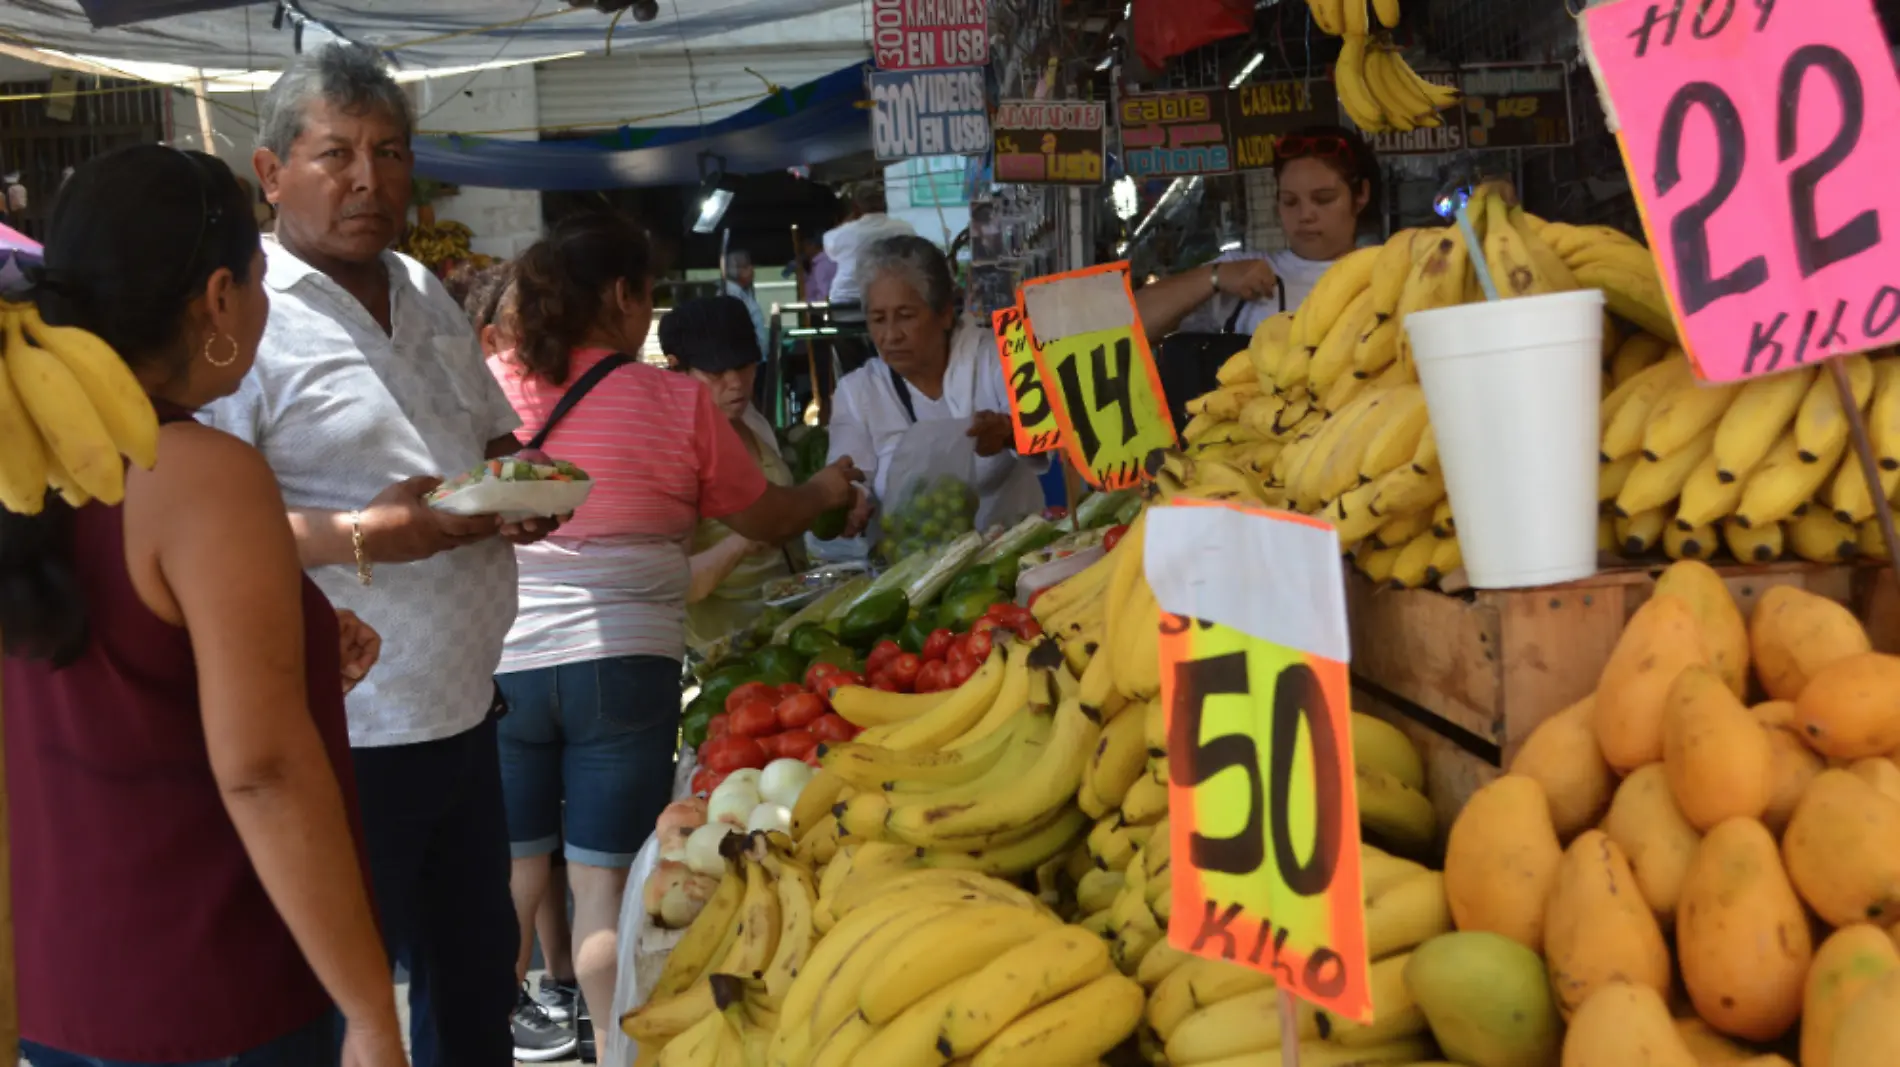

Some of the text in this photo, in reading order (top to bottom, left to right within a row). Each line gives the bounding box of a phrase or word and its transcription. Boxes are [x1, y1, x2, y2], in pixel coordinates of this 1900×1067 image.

[907, 28, 985, 65] EN USB
[912, 72, 983, 113] VIDEOS
[1122, 95, 1209, 121] cable
[1239, 83, 1291, 116] CABLES
[871, 82, 918, 156] 600
[920, 117, 944, 153] EN
[949, 114, 986, 151] USB
[1654, 44, 1882, 317] 22
[1056, 337, 1139, 467] 14
[1098, 457, 1139, 492] KIL
[1167, 650, 1343, 897] 50
[1190, 899, 1347, 998] KILO
